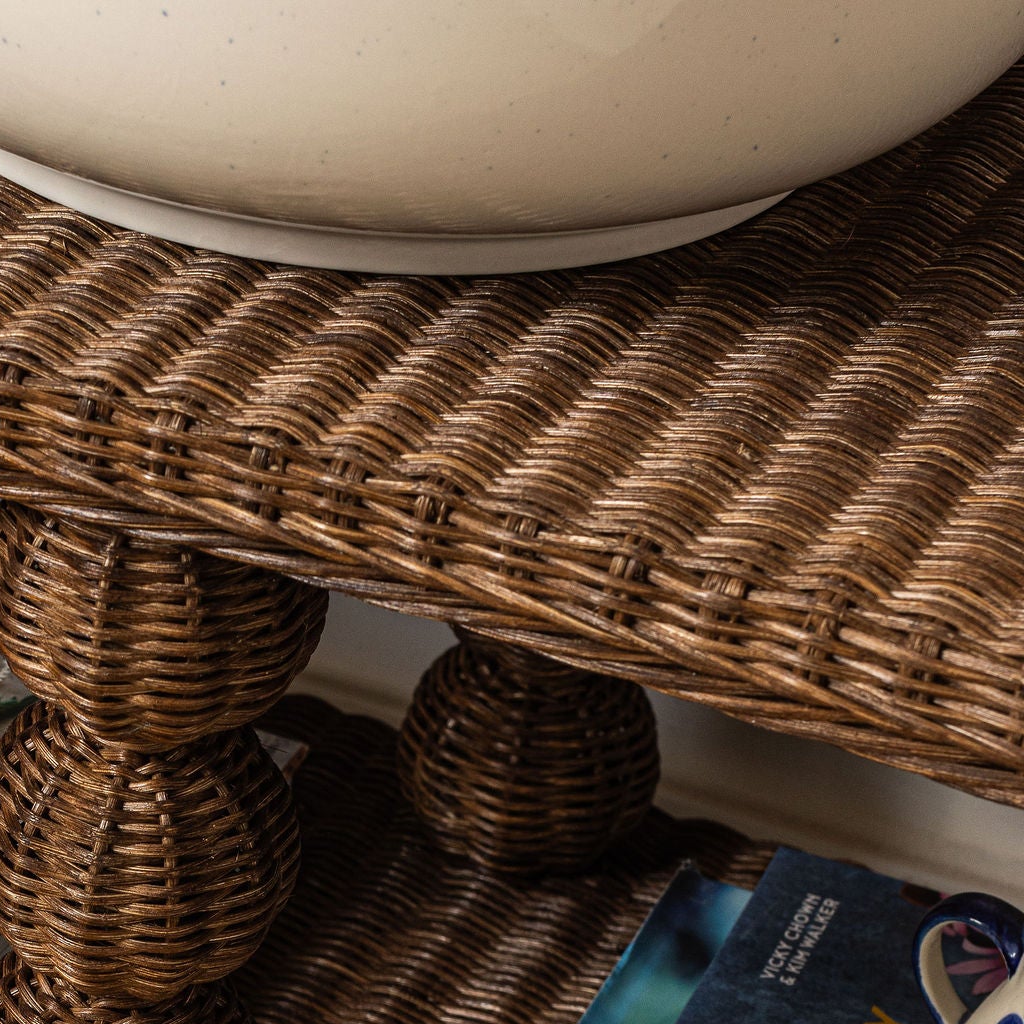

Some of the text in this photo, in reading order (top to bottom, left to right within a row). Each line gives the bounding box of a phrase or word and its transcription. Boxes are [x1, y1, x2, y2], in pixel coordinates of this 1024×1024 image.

[759, 893, 822, 979] VICKY CHOWN
[779, 898, 840, 986] & KIM WALKER
